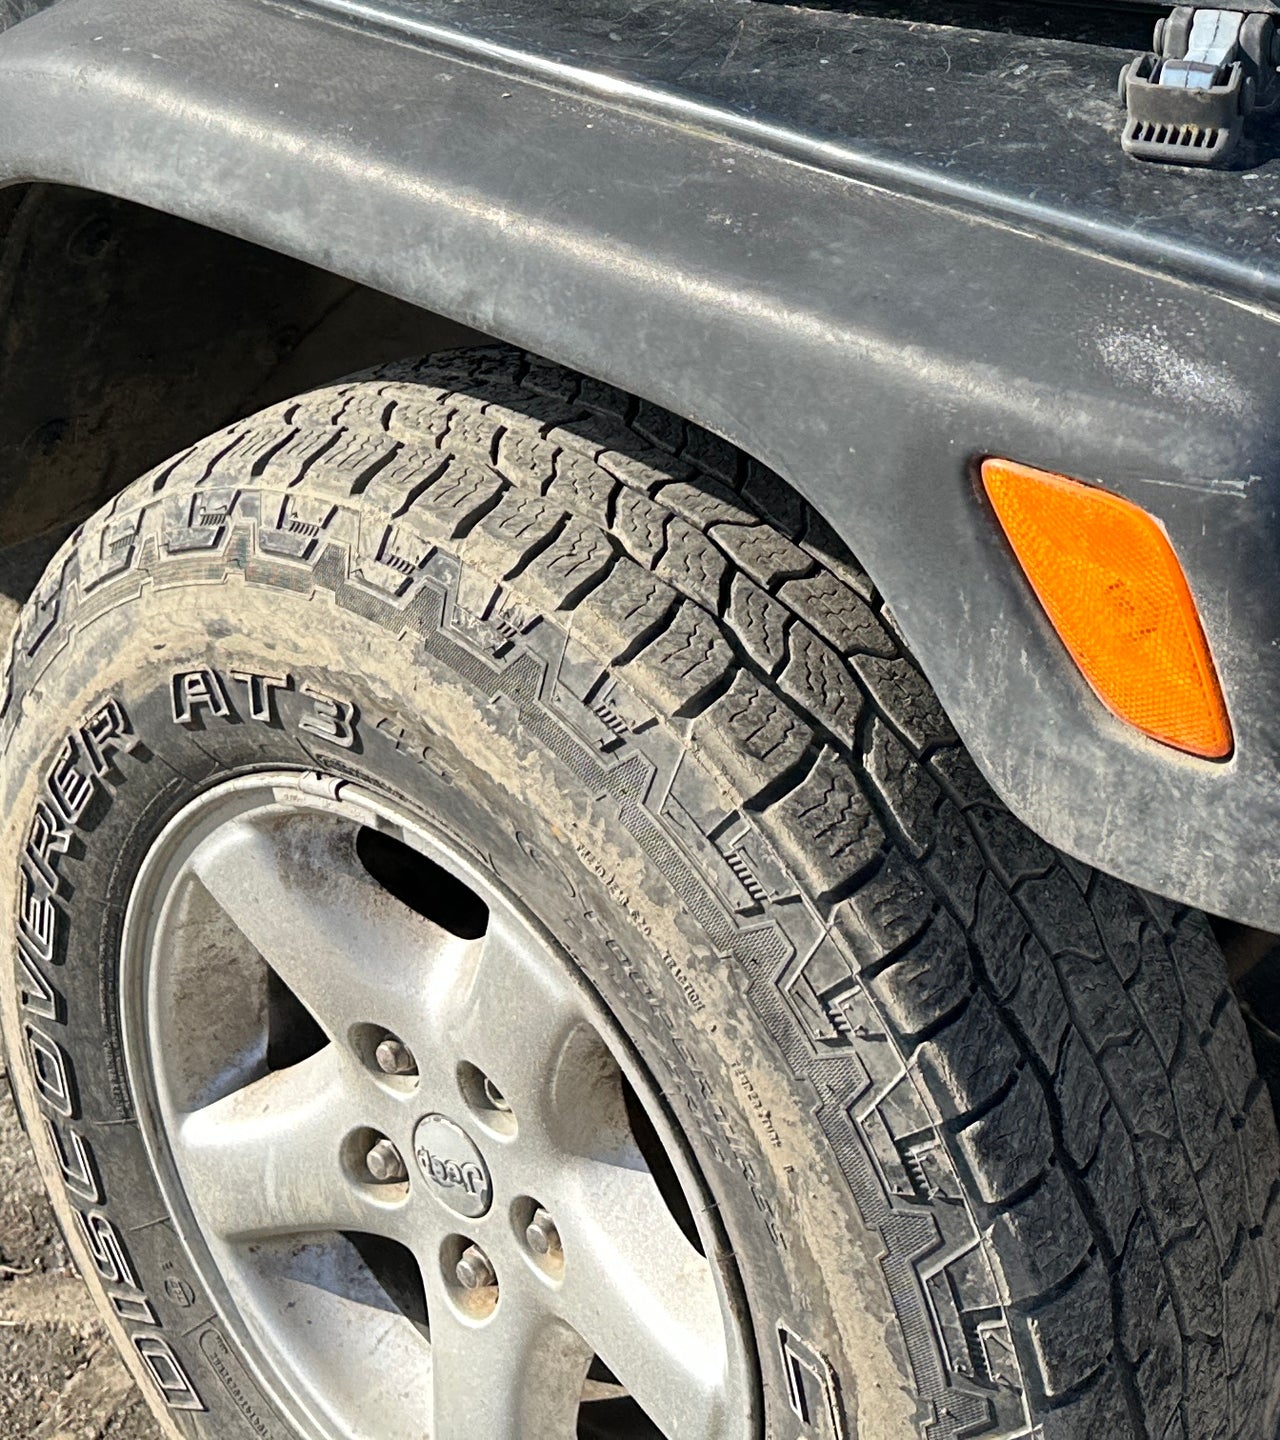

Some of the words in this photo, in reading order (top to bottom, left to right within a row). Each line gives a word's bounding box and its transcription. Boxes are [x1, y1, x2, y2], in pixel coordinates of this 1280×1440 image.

[16, 694, 207, 1412] DISCOVERER
[169, 663, 363, 750] AT3
[417, 1146, 484, 1194] Jeep
